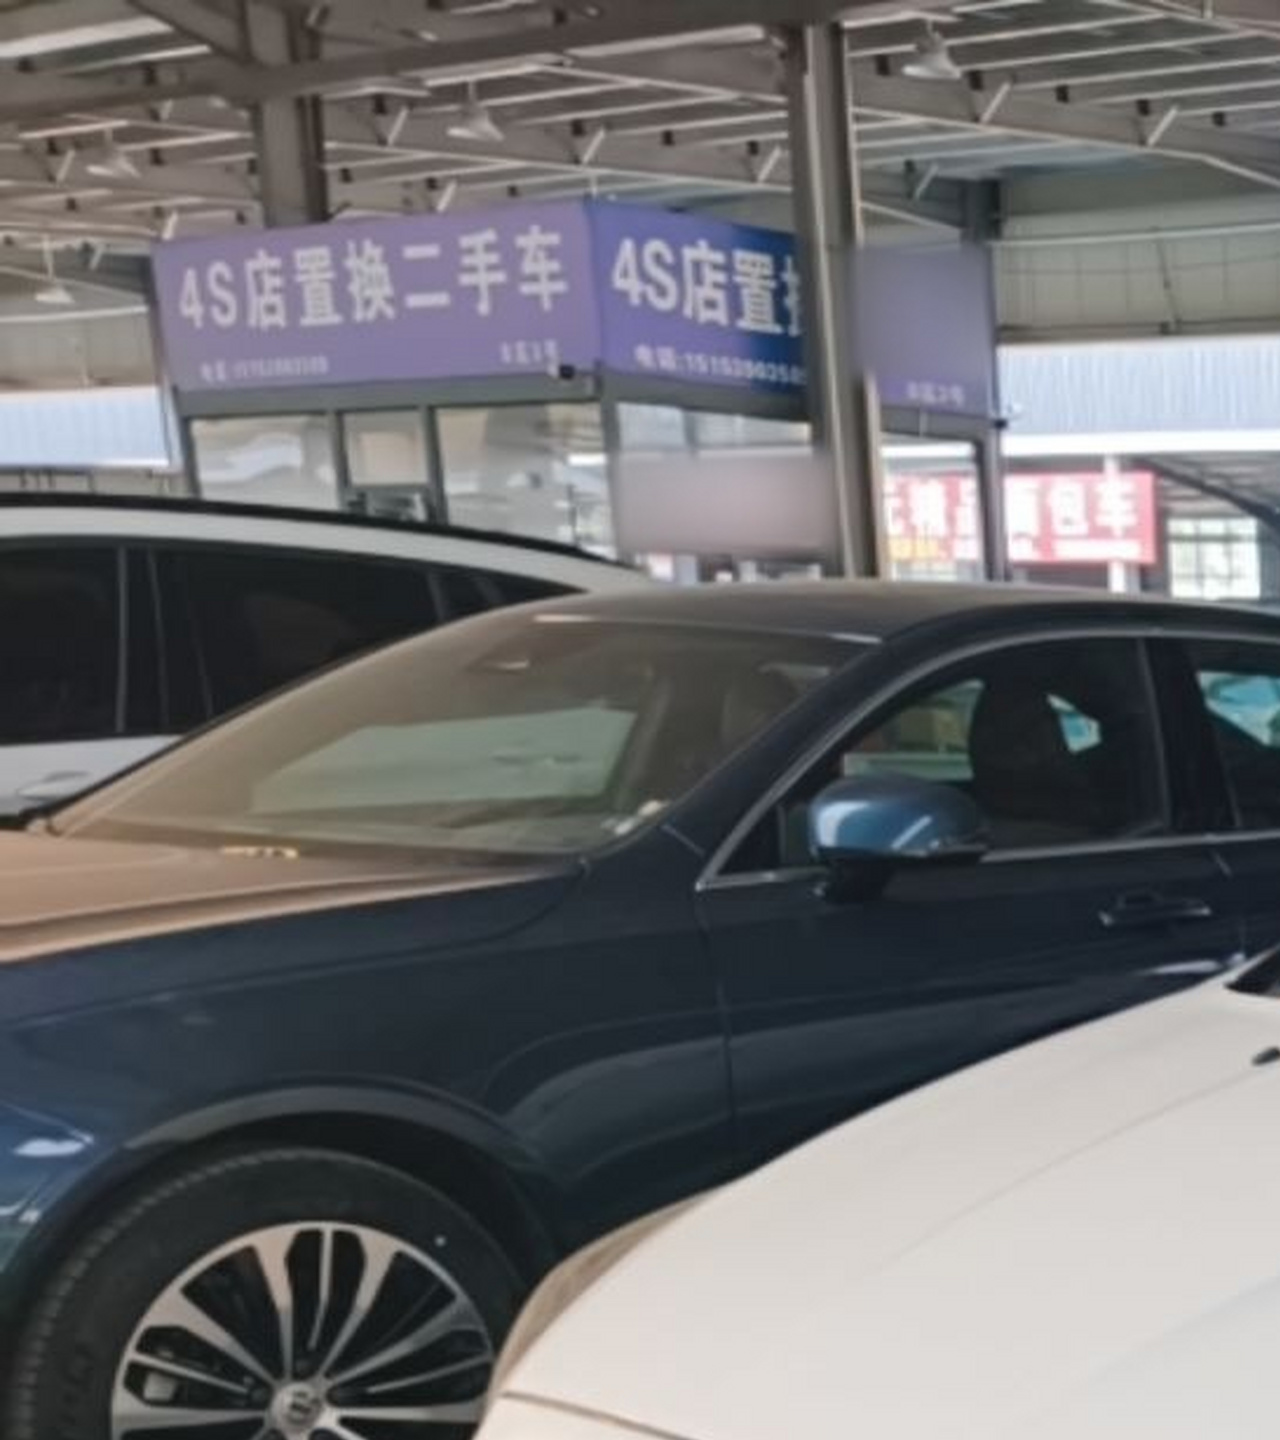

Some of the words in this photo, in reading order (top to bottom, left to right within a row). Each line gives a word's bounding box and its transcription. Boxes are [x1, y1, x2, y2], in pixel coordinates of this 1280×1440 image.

[178, 225, 568, 330] 4S店置换二手车
